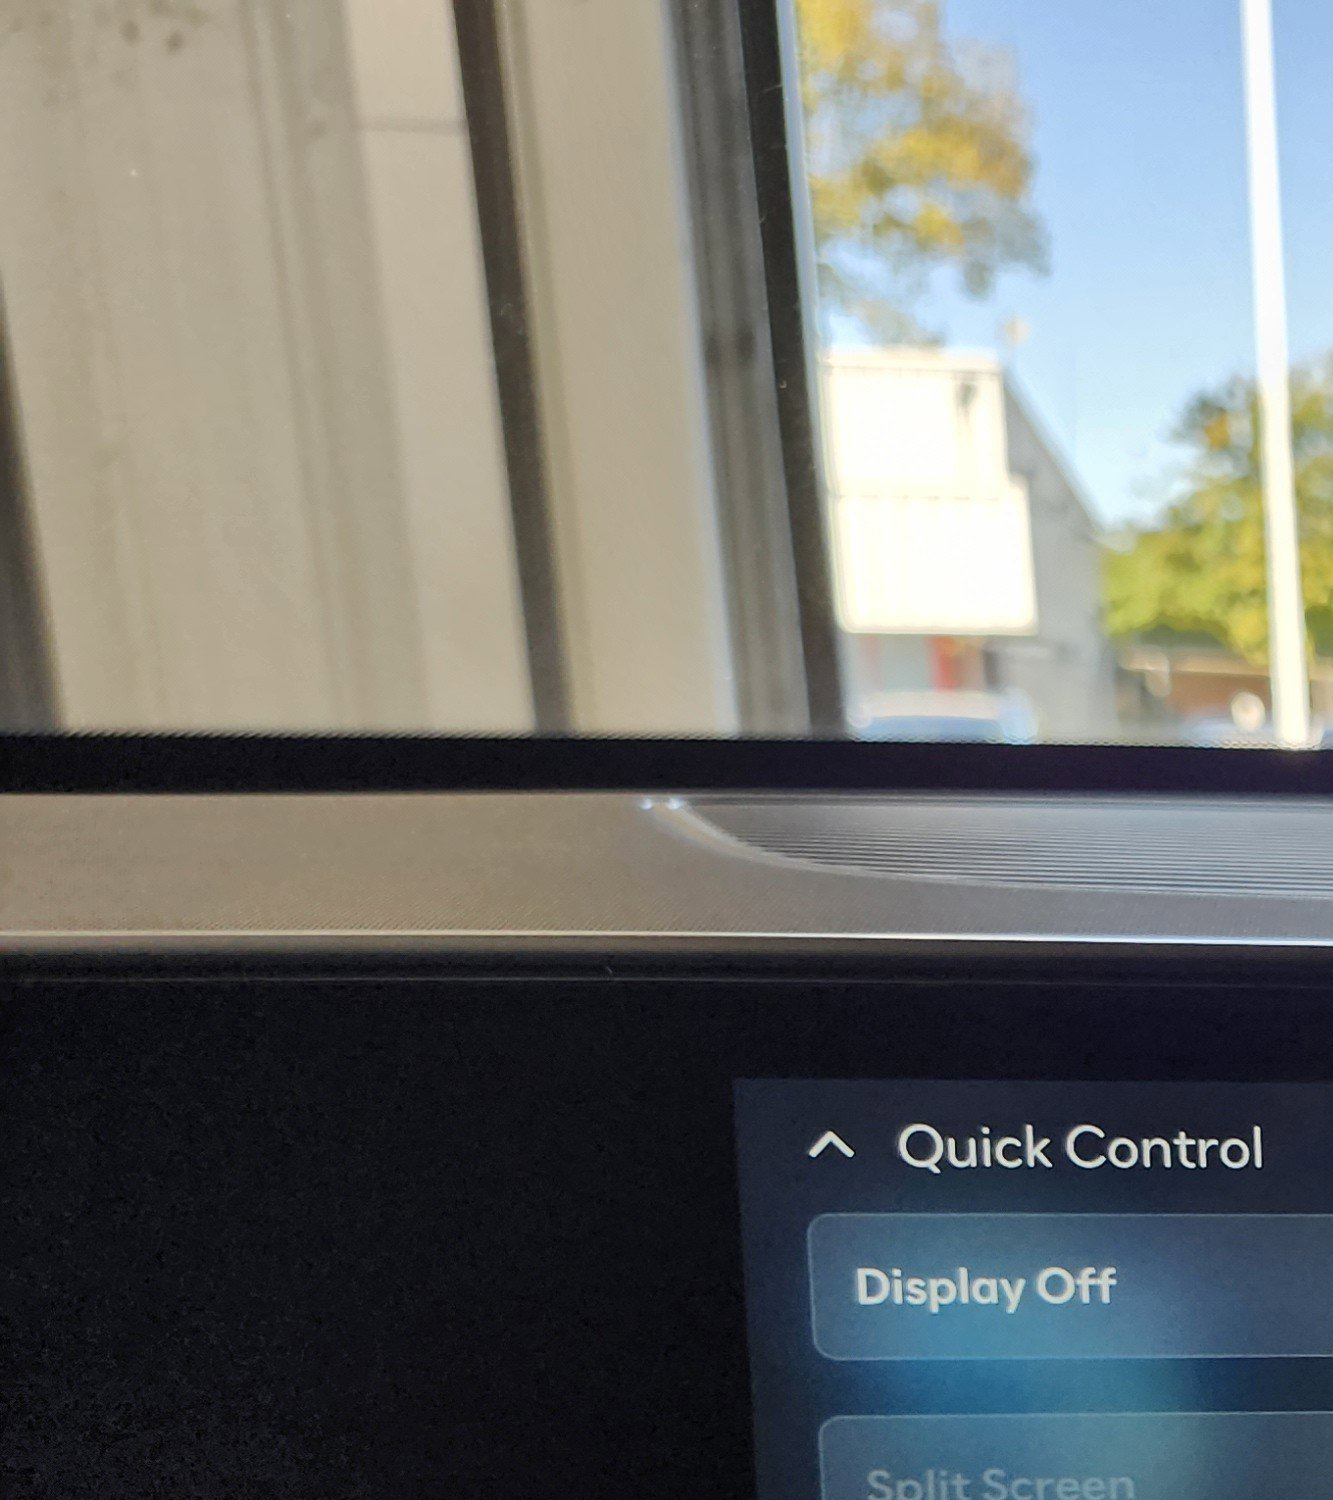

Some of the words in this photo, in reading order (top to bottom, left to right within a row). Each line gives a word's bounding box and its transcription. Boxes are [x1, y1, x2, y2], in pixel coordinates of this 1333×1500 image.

[898, 1124, 1053, 1174] Quick
[1064, 1124, 1264, 1170] Control
[855, 1266, 1026, 1314] Display
[1036, 1264, 1118, 1307] Off
